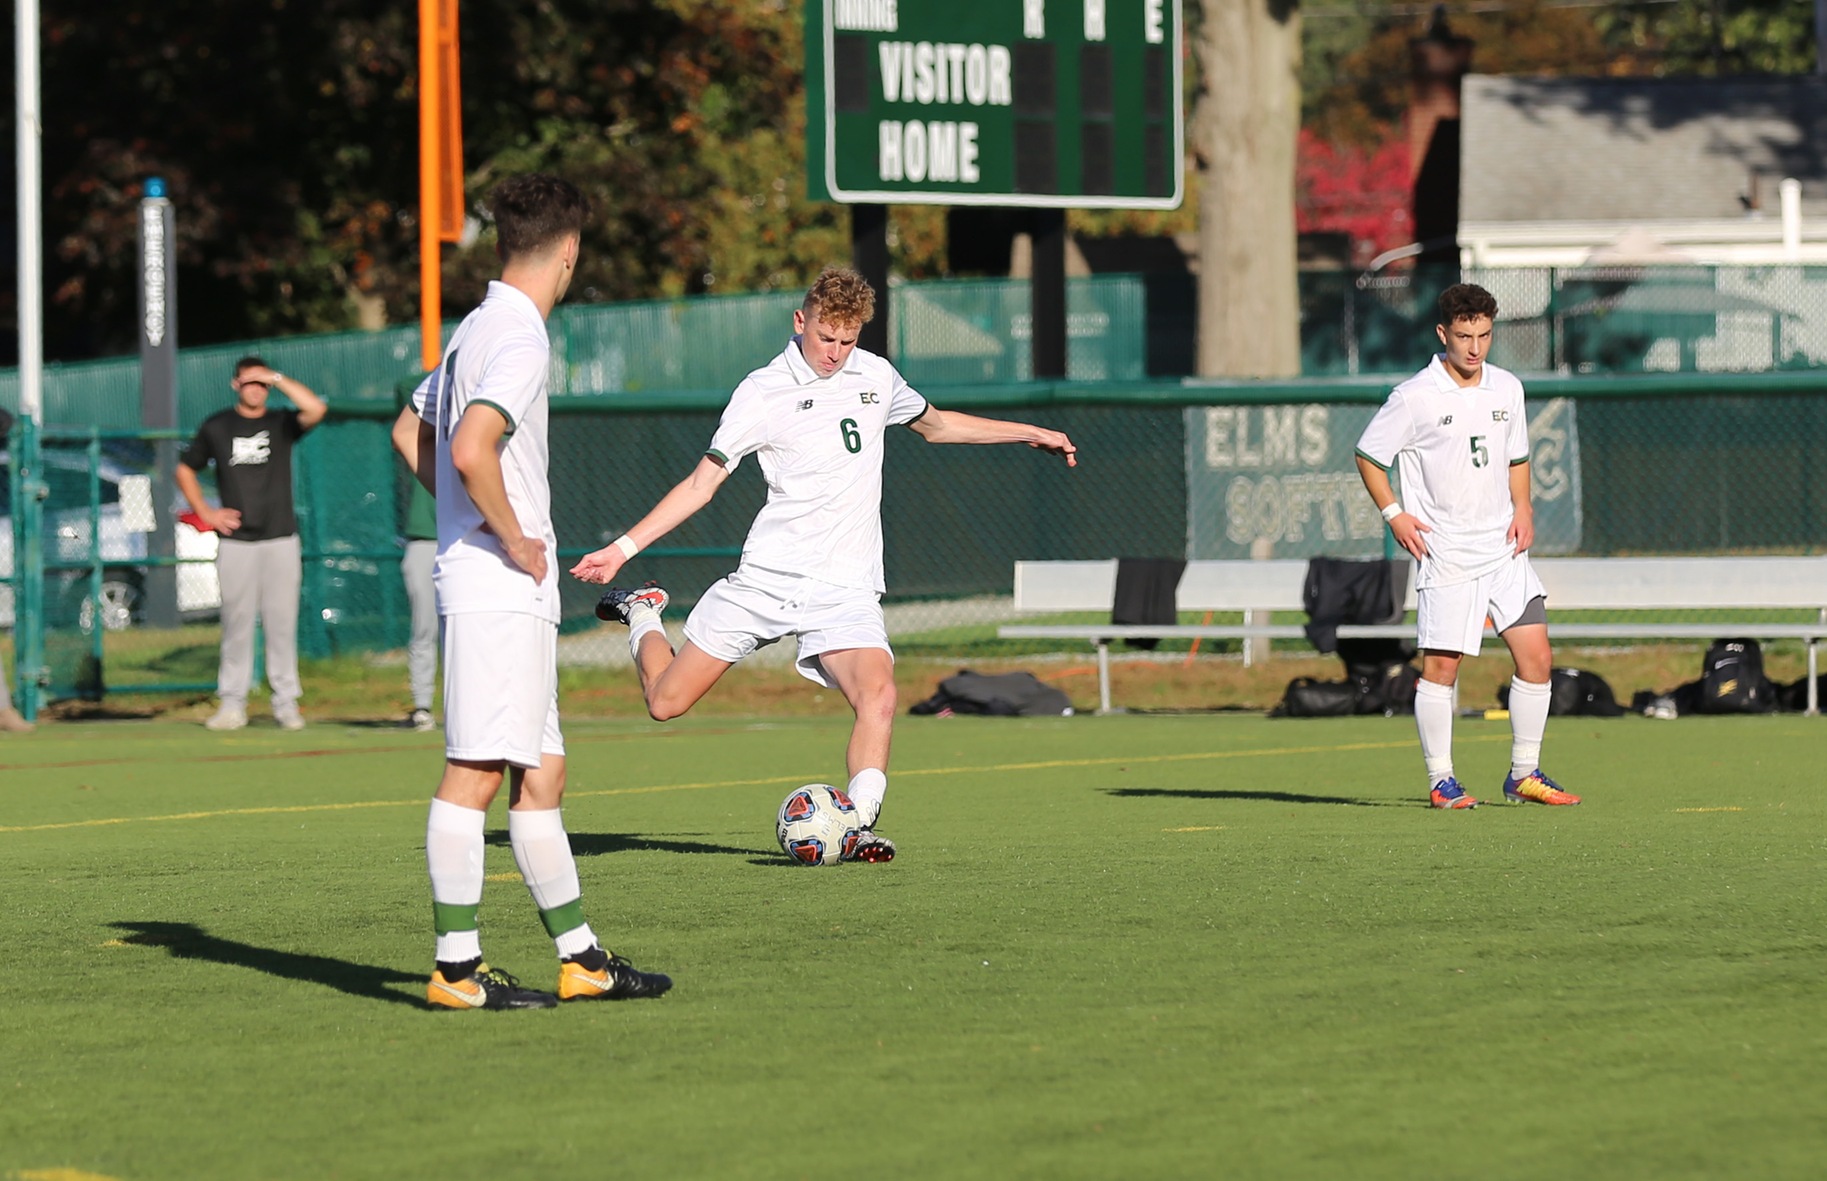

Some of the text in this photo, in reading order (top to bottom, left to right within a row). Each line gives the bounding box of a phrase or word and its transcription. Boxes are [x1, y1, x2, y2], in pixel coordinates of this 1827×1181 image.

[1144, 0, 1164, 44] E
[878, 40, 1012, 105] VISITOR
[878, 120, 980, 183] HOME
[840, 417, 862, 454] 6
[1205, 403, 1330, 467] ELMS
[1491, 410, 1509, 422] EC
[1469, 435, 1489, 468] 5
